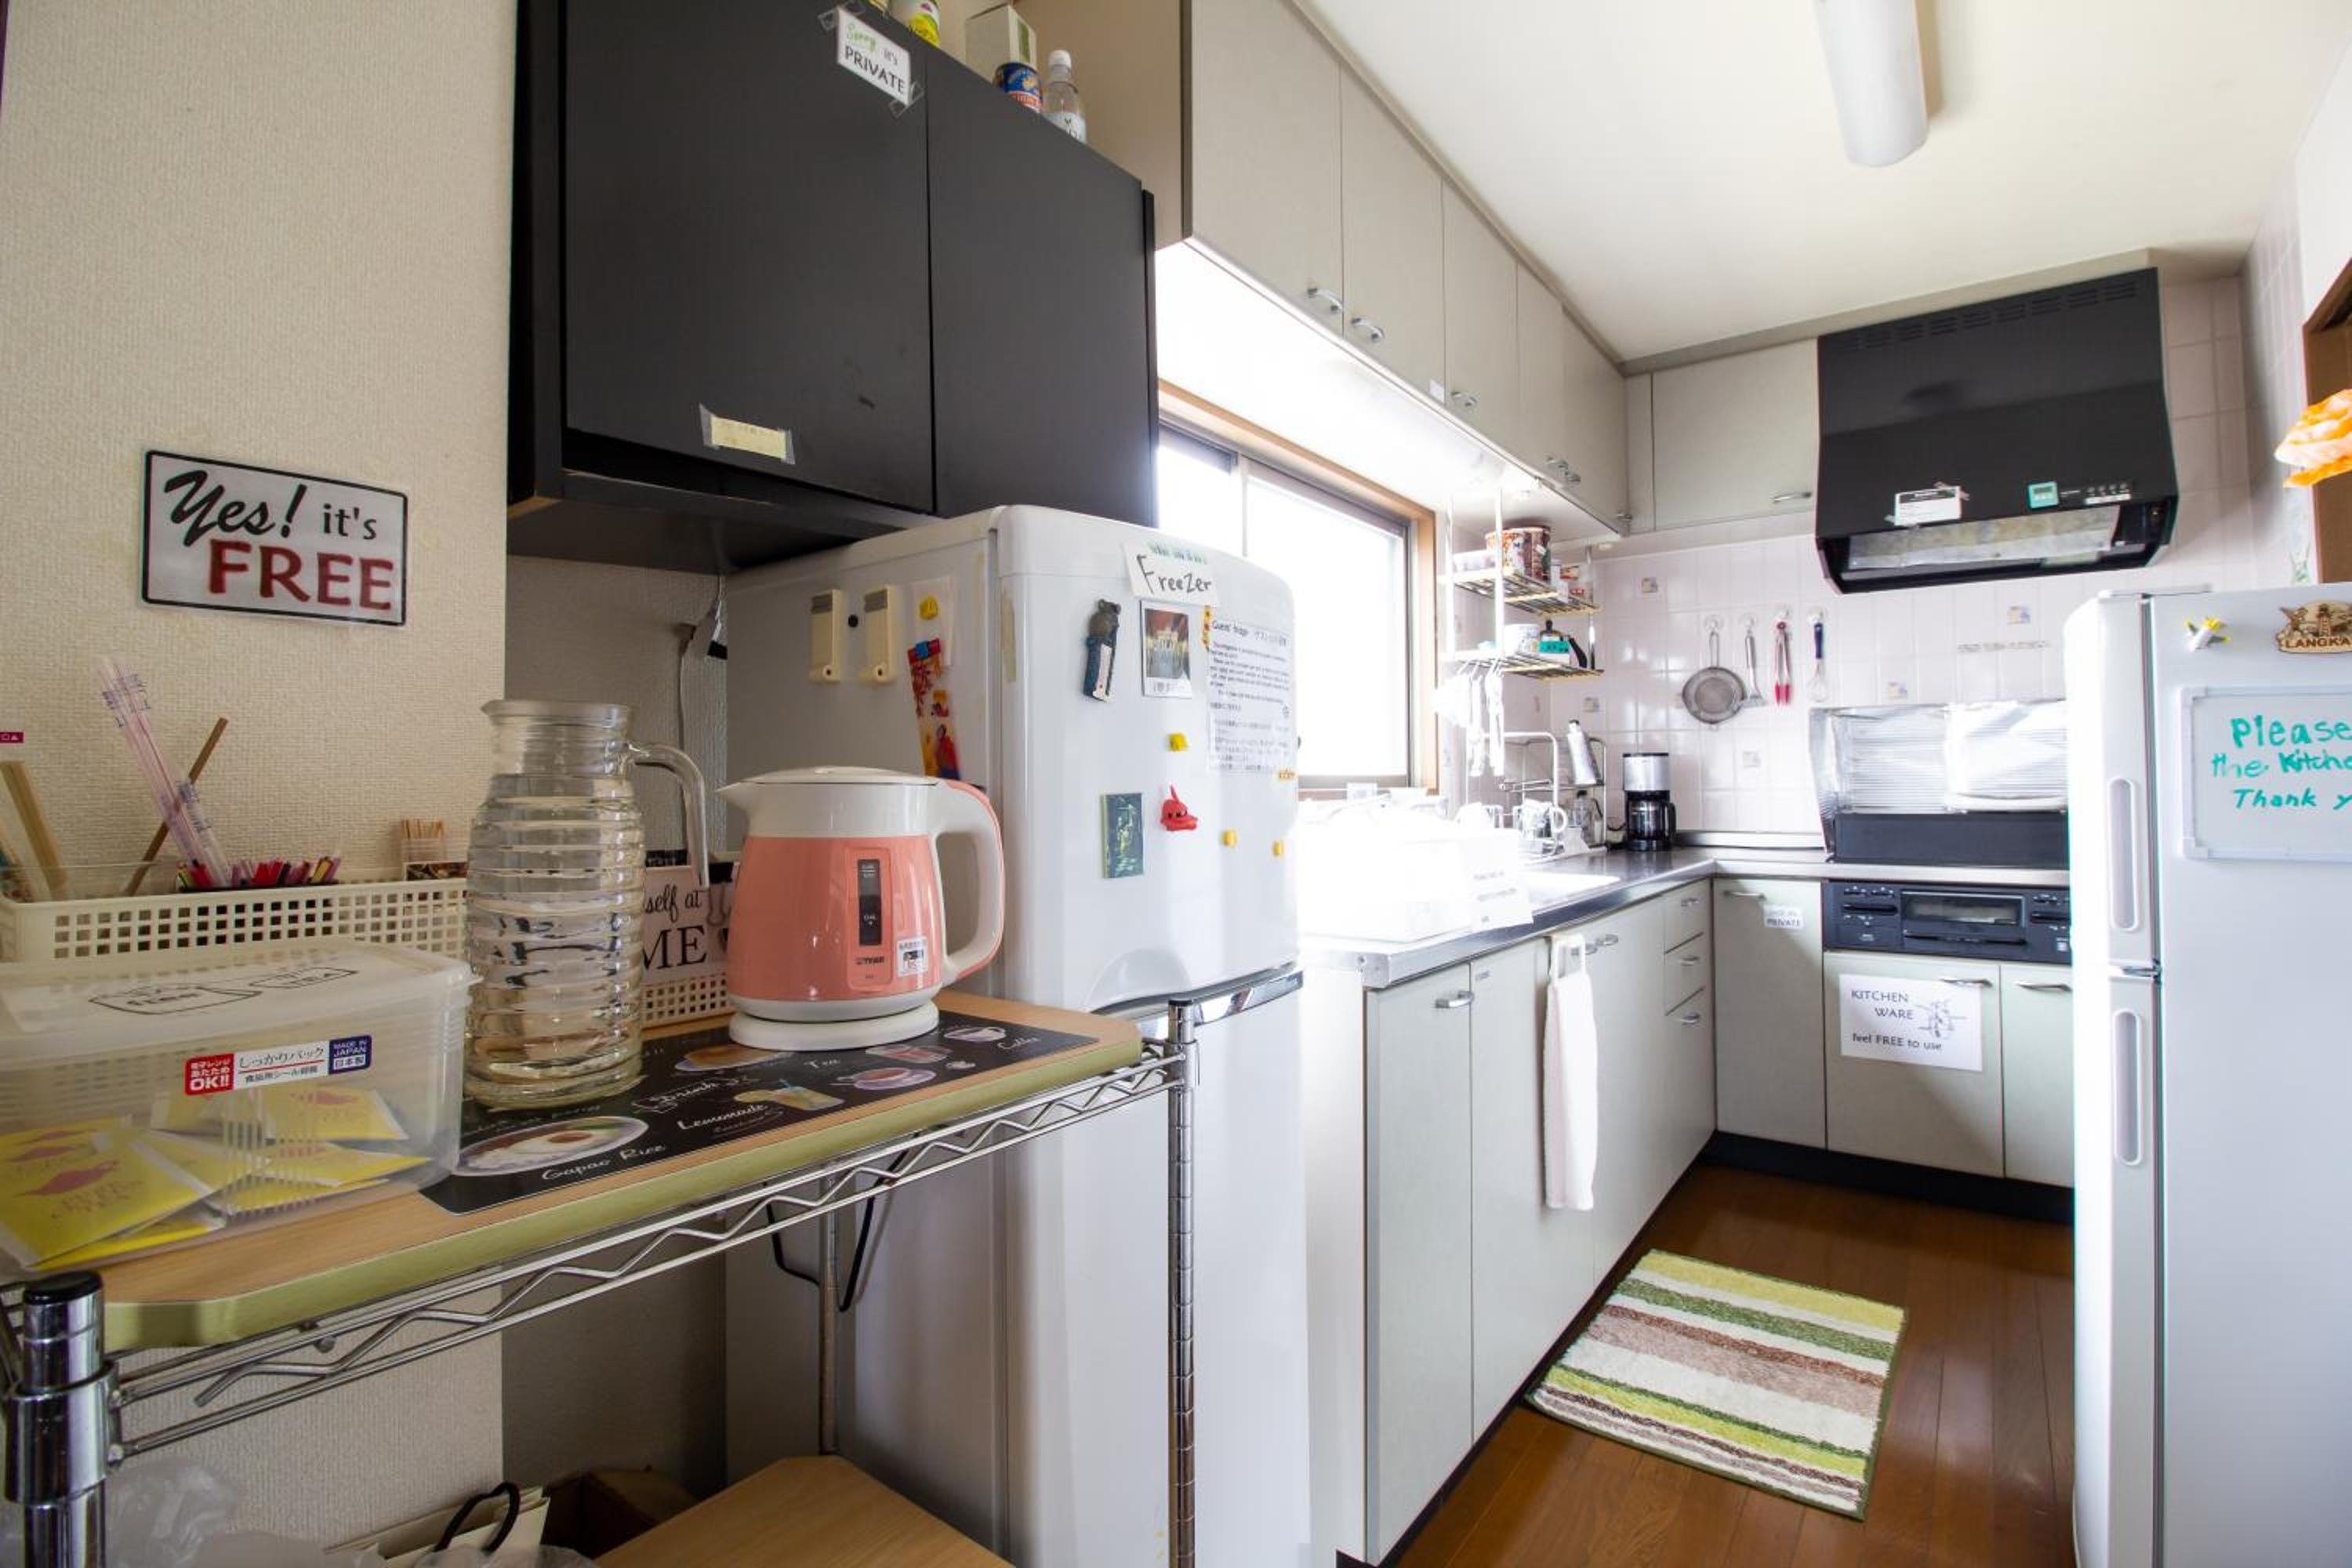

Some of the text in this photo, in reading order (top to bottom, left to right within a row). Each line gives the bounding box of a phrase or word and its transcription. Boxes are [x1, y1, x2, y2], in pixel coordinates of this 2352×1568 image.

[844, 45, 906, 95] PRIVATE
[163, 470, 378, 547] Yes! it's
[208, 538, 394, 611] FREE
[2285, 637, 2352, 648] LANGKA
[2230, 714, 2352, 749] Please
[2211, 753, 2269, 778] the
[2233, 787, 2317, 809] Thank
[684, 890, 706, 909] at
[1851, 990, 1908, 1002] KITCHEN
[1875, 1007, 1914, 1020] WARE
[1875, 1034, 1904, 1047] FREE
[1907, 1039, 1920, 1049] to
[239, 1046, 324, 1069] しっかりパック
[333, 1047, 368, 1057] JAPAN
[190, 1075, 230, 1091] OK!!
